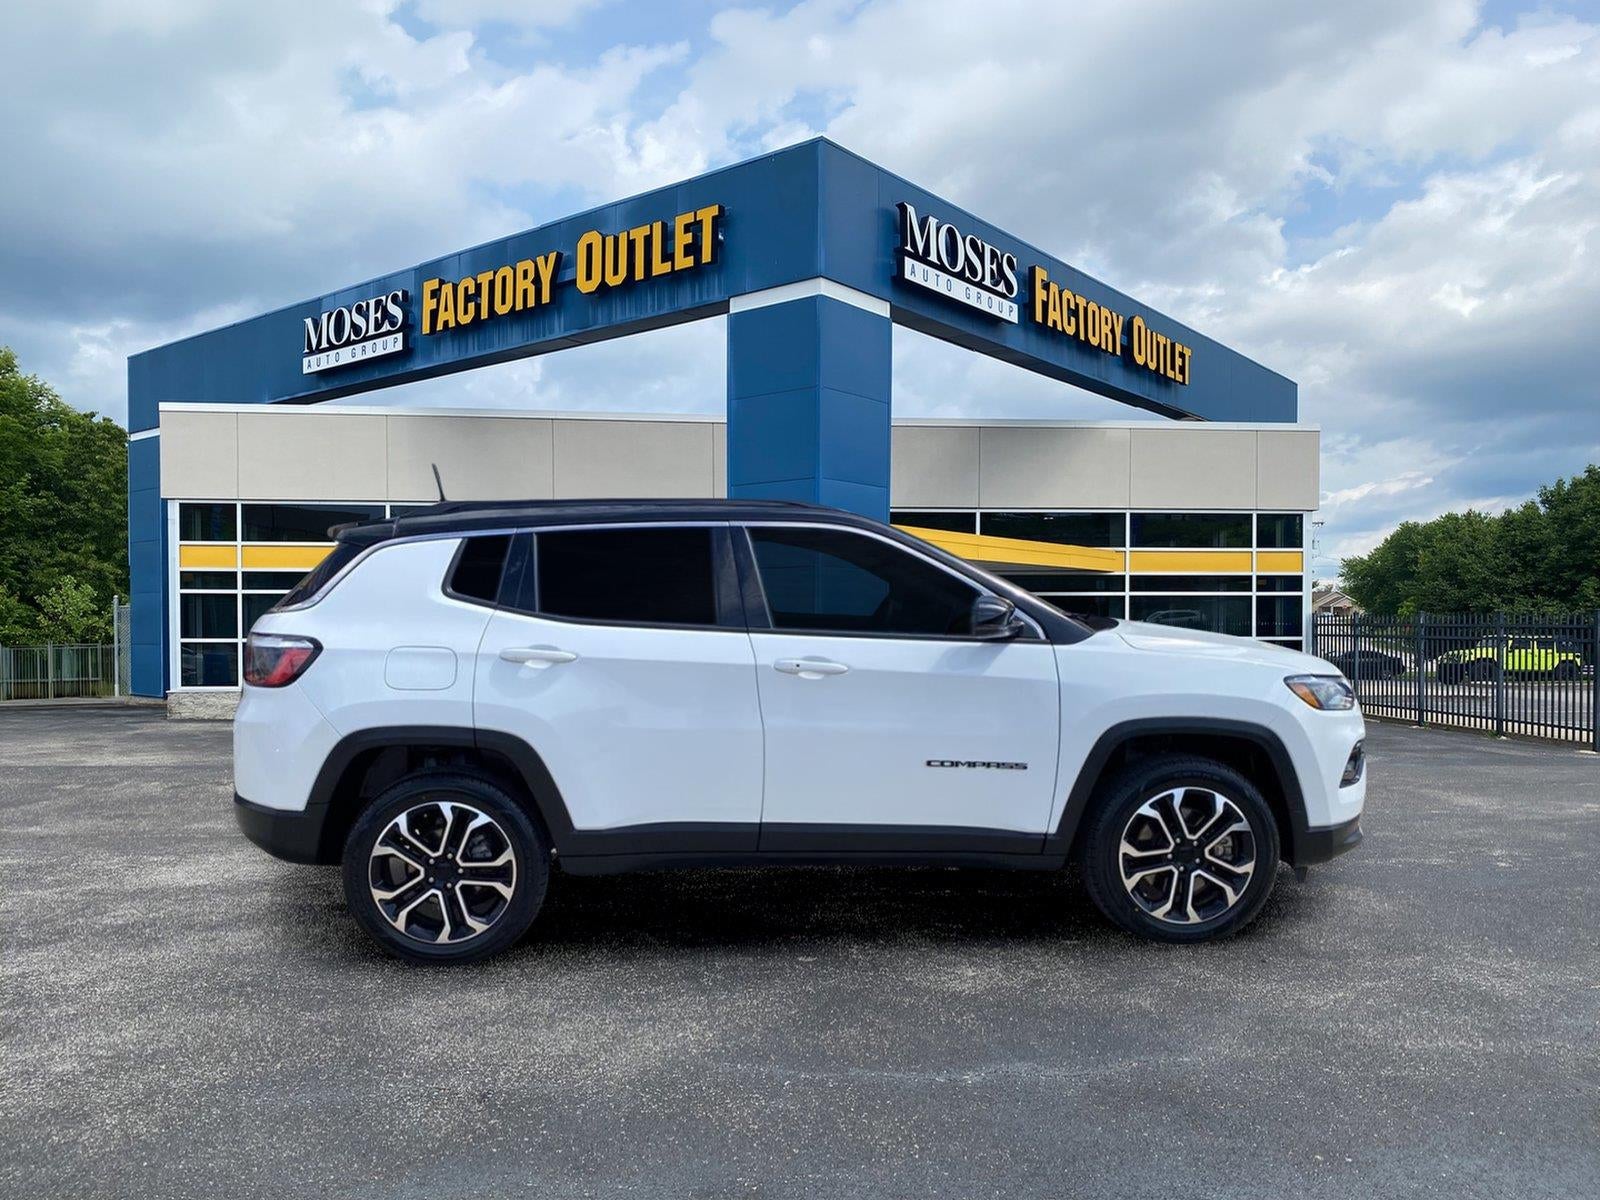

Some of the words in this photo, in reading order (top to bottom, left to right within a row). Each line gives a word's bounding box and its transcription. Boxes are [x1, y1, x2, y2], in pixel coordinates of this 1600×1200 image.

[421, 251, 560, 335] FACTORY
[576, 203, 721, 295] OUTLET
[903, 202, 1019, 298] MOSES
[303, 289, 404, 353] MOSES
[909, 263, 952, 293] AUTO
[965, 285, 1015, 317] GROUP
[306, 352, 341, 370] AUTO
[350, 336, 399, 359] GROUP
[1034, 264, 1124, 356] FACTORY
[1132, 315, 1192, 385] OUTLET
[926, 759, 1028, 770] COMPASS
